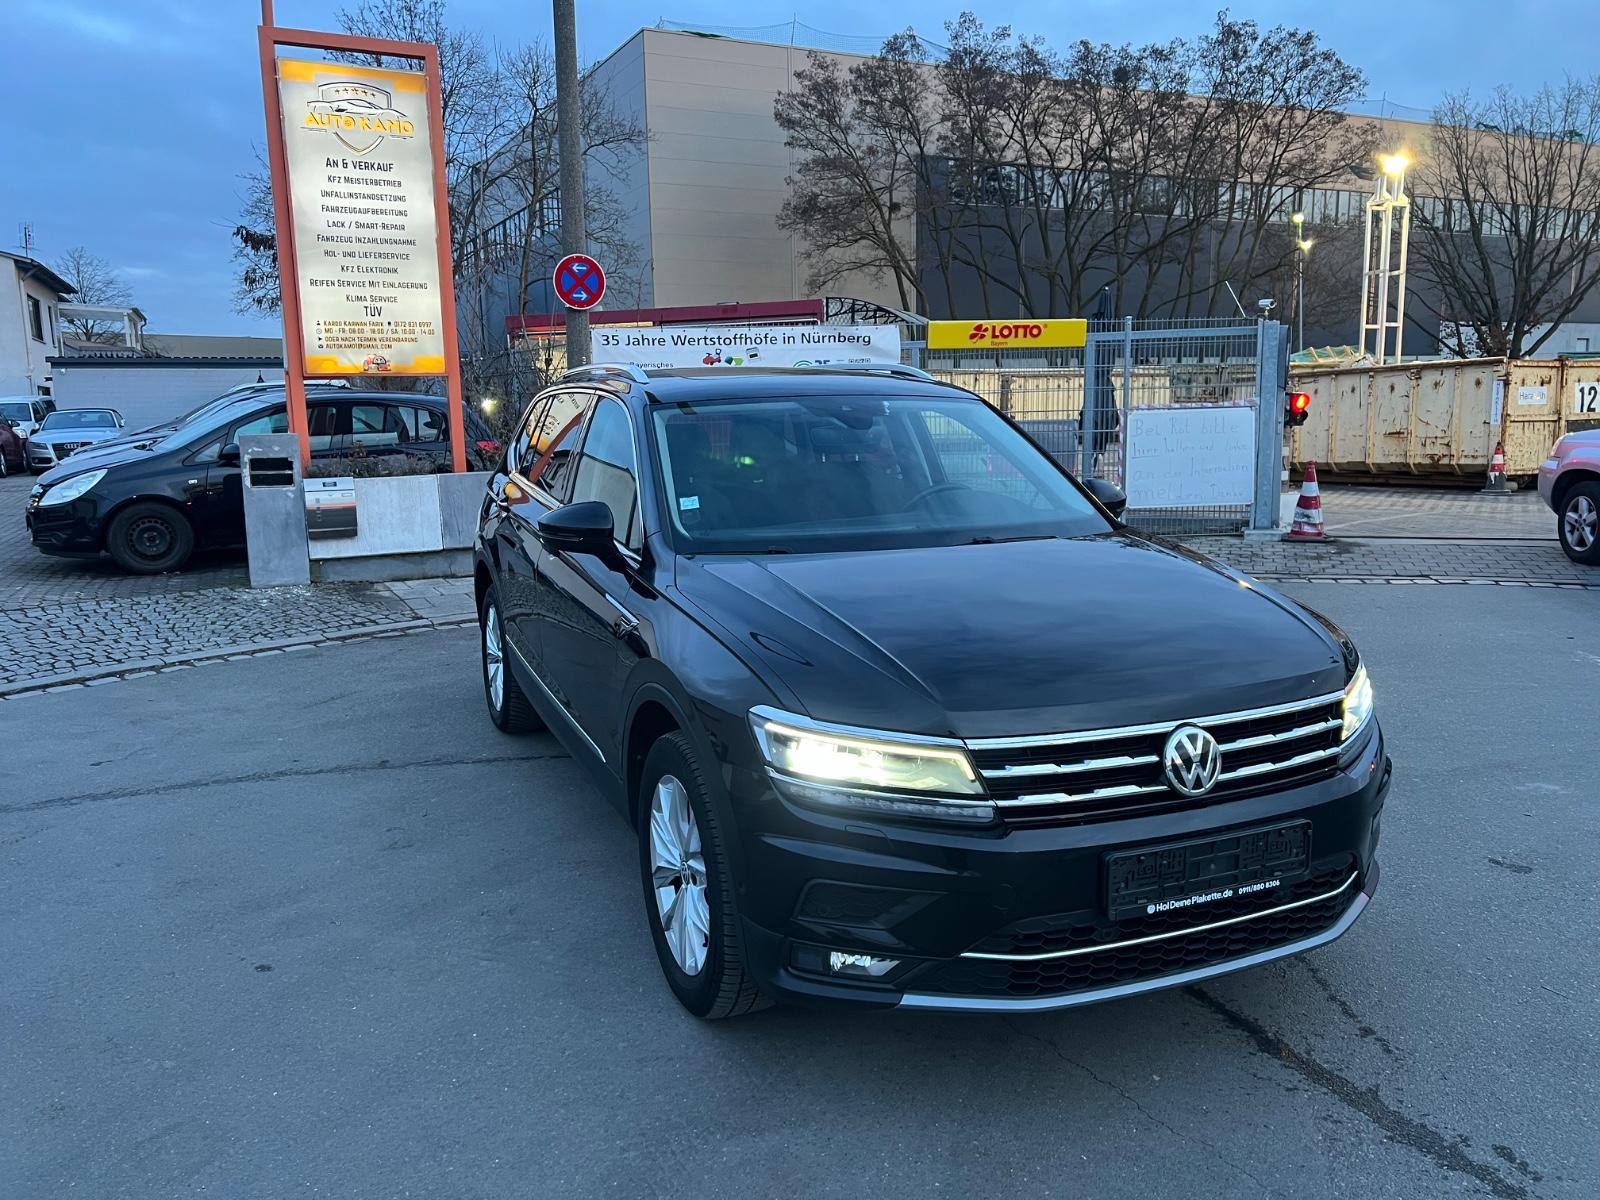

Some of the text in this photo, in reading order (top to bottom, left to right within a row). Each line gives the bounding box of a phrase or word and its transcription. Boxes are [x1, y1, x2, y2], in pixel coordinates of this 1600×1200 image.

[304, 112, 355, 131] AUTO
[342, 159, 348, 169] &
[327, 220, 346, 228] LACK
[354, 221, 406, 231] SMART-REPAIR
[317, 234, 353, 243] FAHRZEUG
[358, 251, 410, 260] LIEFERSERVICE
[356, 265, 399, 274] ELEKTRONIK
[310, 279, 335, 287] REIFEN
[337, 280, 366, 288] SERVICE
[346, 295, 398, 303] KLIMA SERVICE
[364, 304, 382, 317] TÜV
[991, 324, 1042, 339] LOTTO
[601, 332, 872, 347] 35 Jahre Wertstoffhöfe in Nürnberg
[1579, 386, 1598, 413] 12
[1131, 416, 1239, 437] Bei Rot bitte
